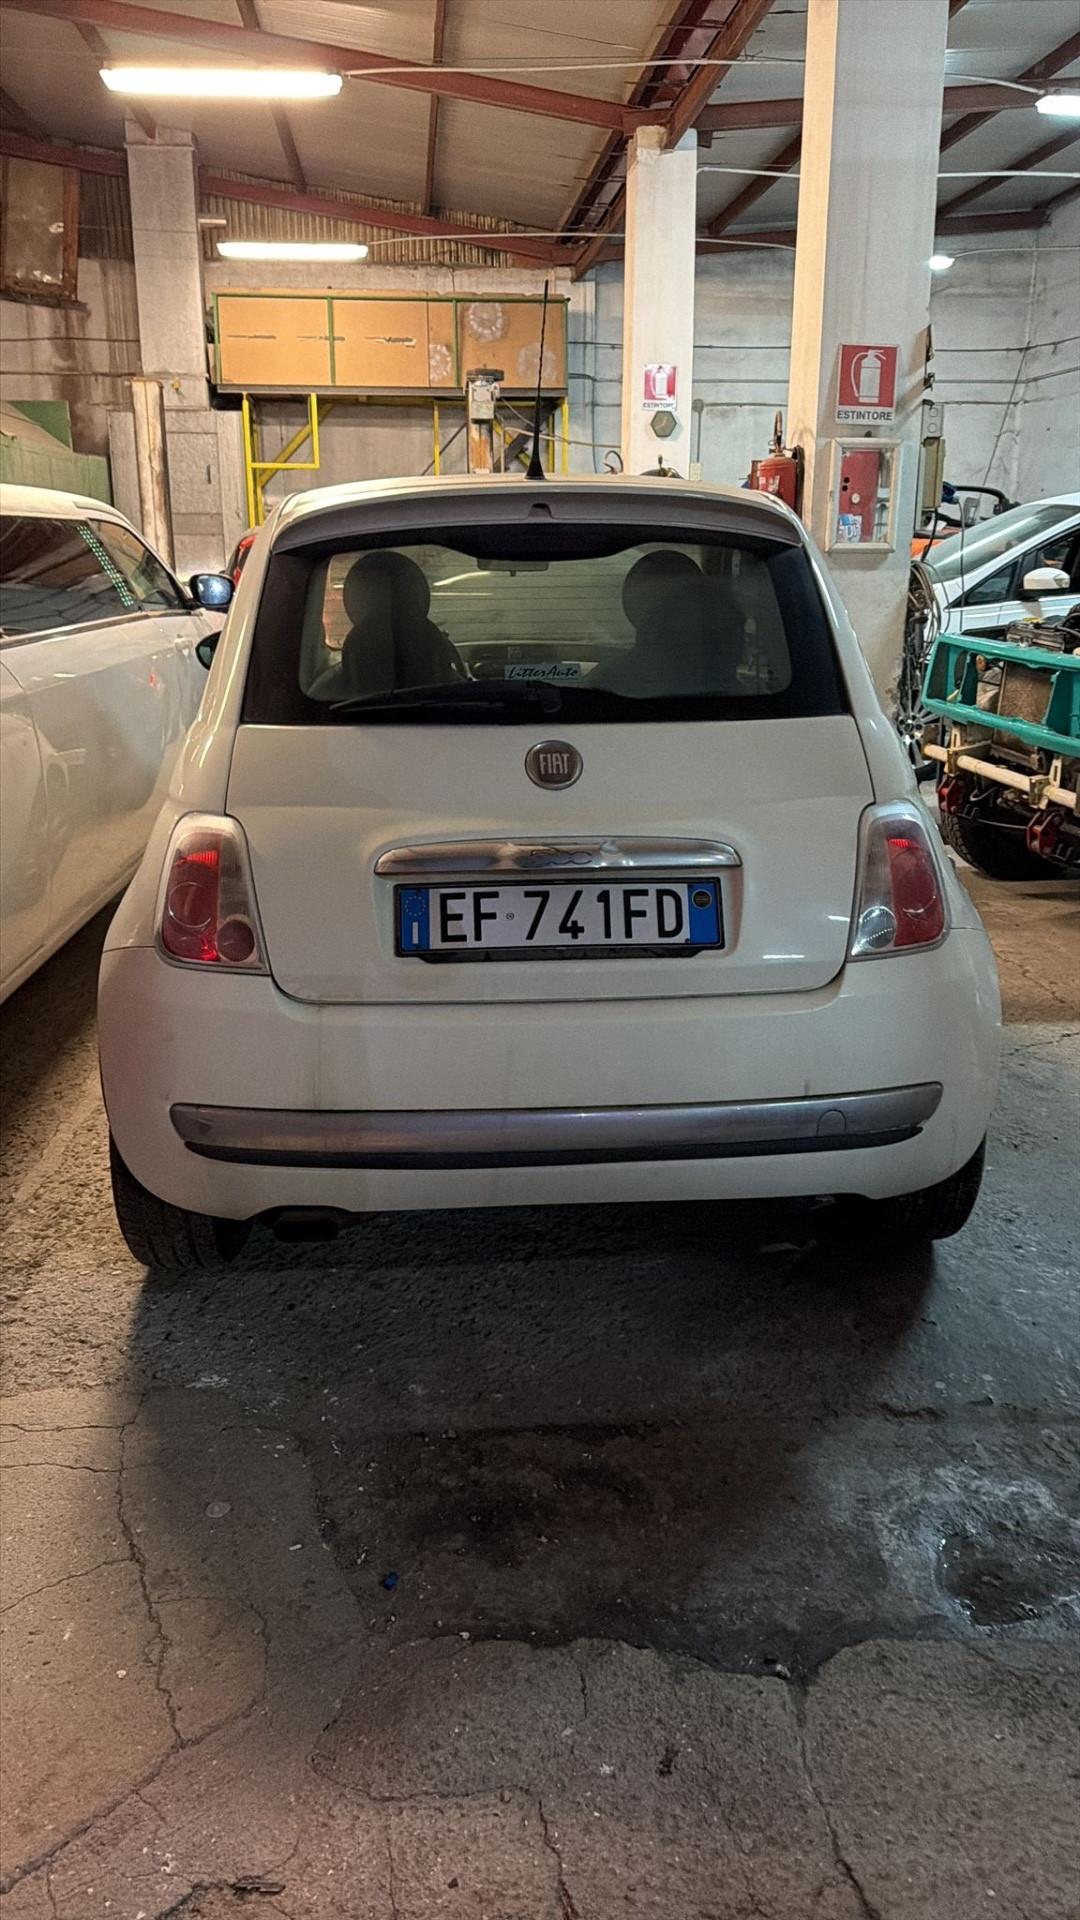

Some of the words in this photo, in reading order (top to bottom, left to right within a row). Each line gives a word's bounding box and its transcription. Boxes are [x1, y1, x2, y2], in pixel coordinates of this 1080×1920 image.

[837, 410, 893, 420] ESTINTORE
[540, 753, 569, 774] FIAT
[439, 891, 499, 943] EF
[523, 888, 684, 940] 741FD
